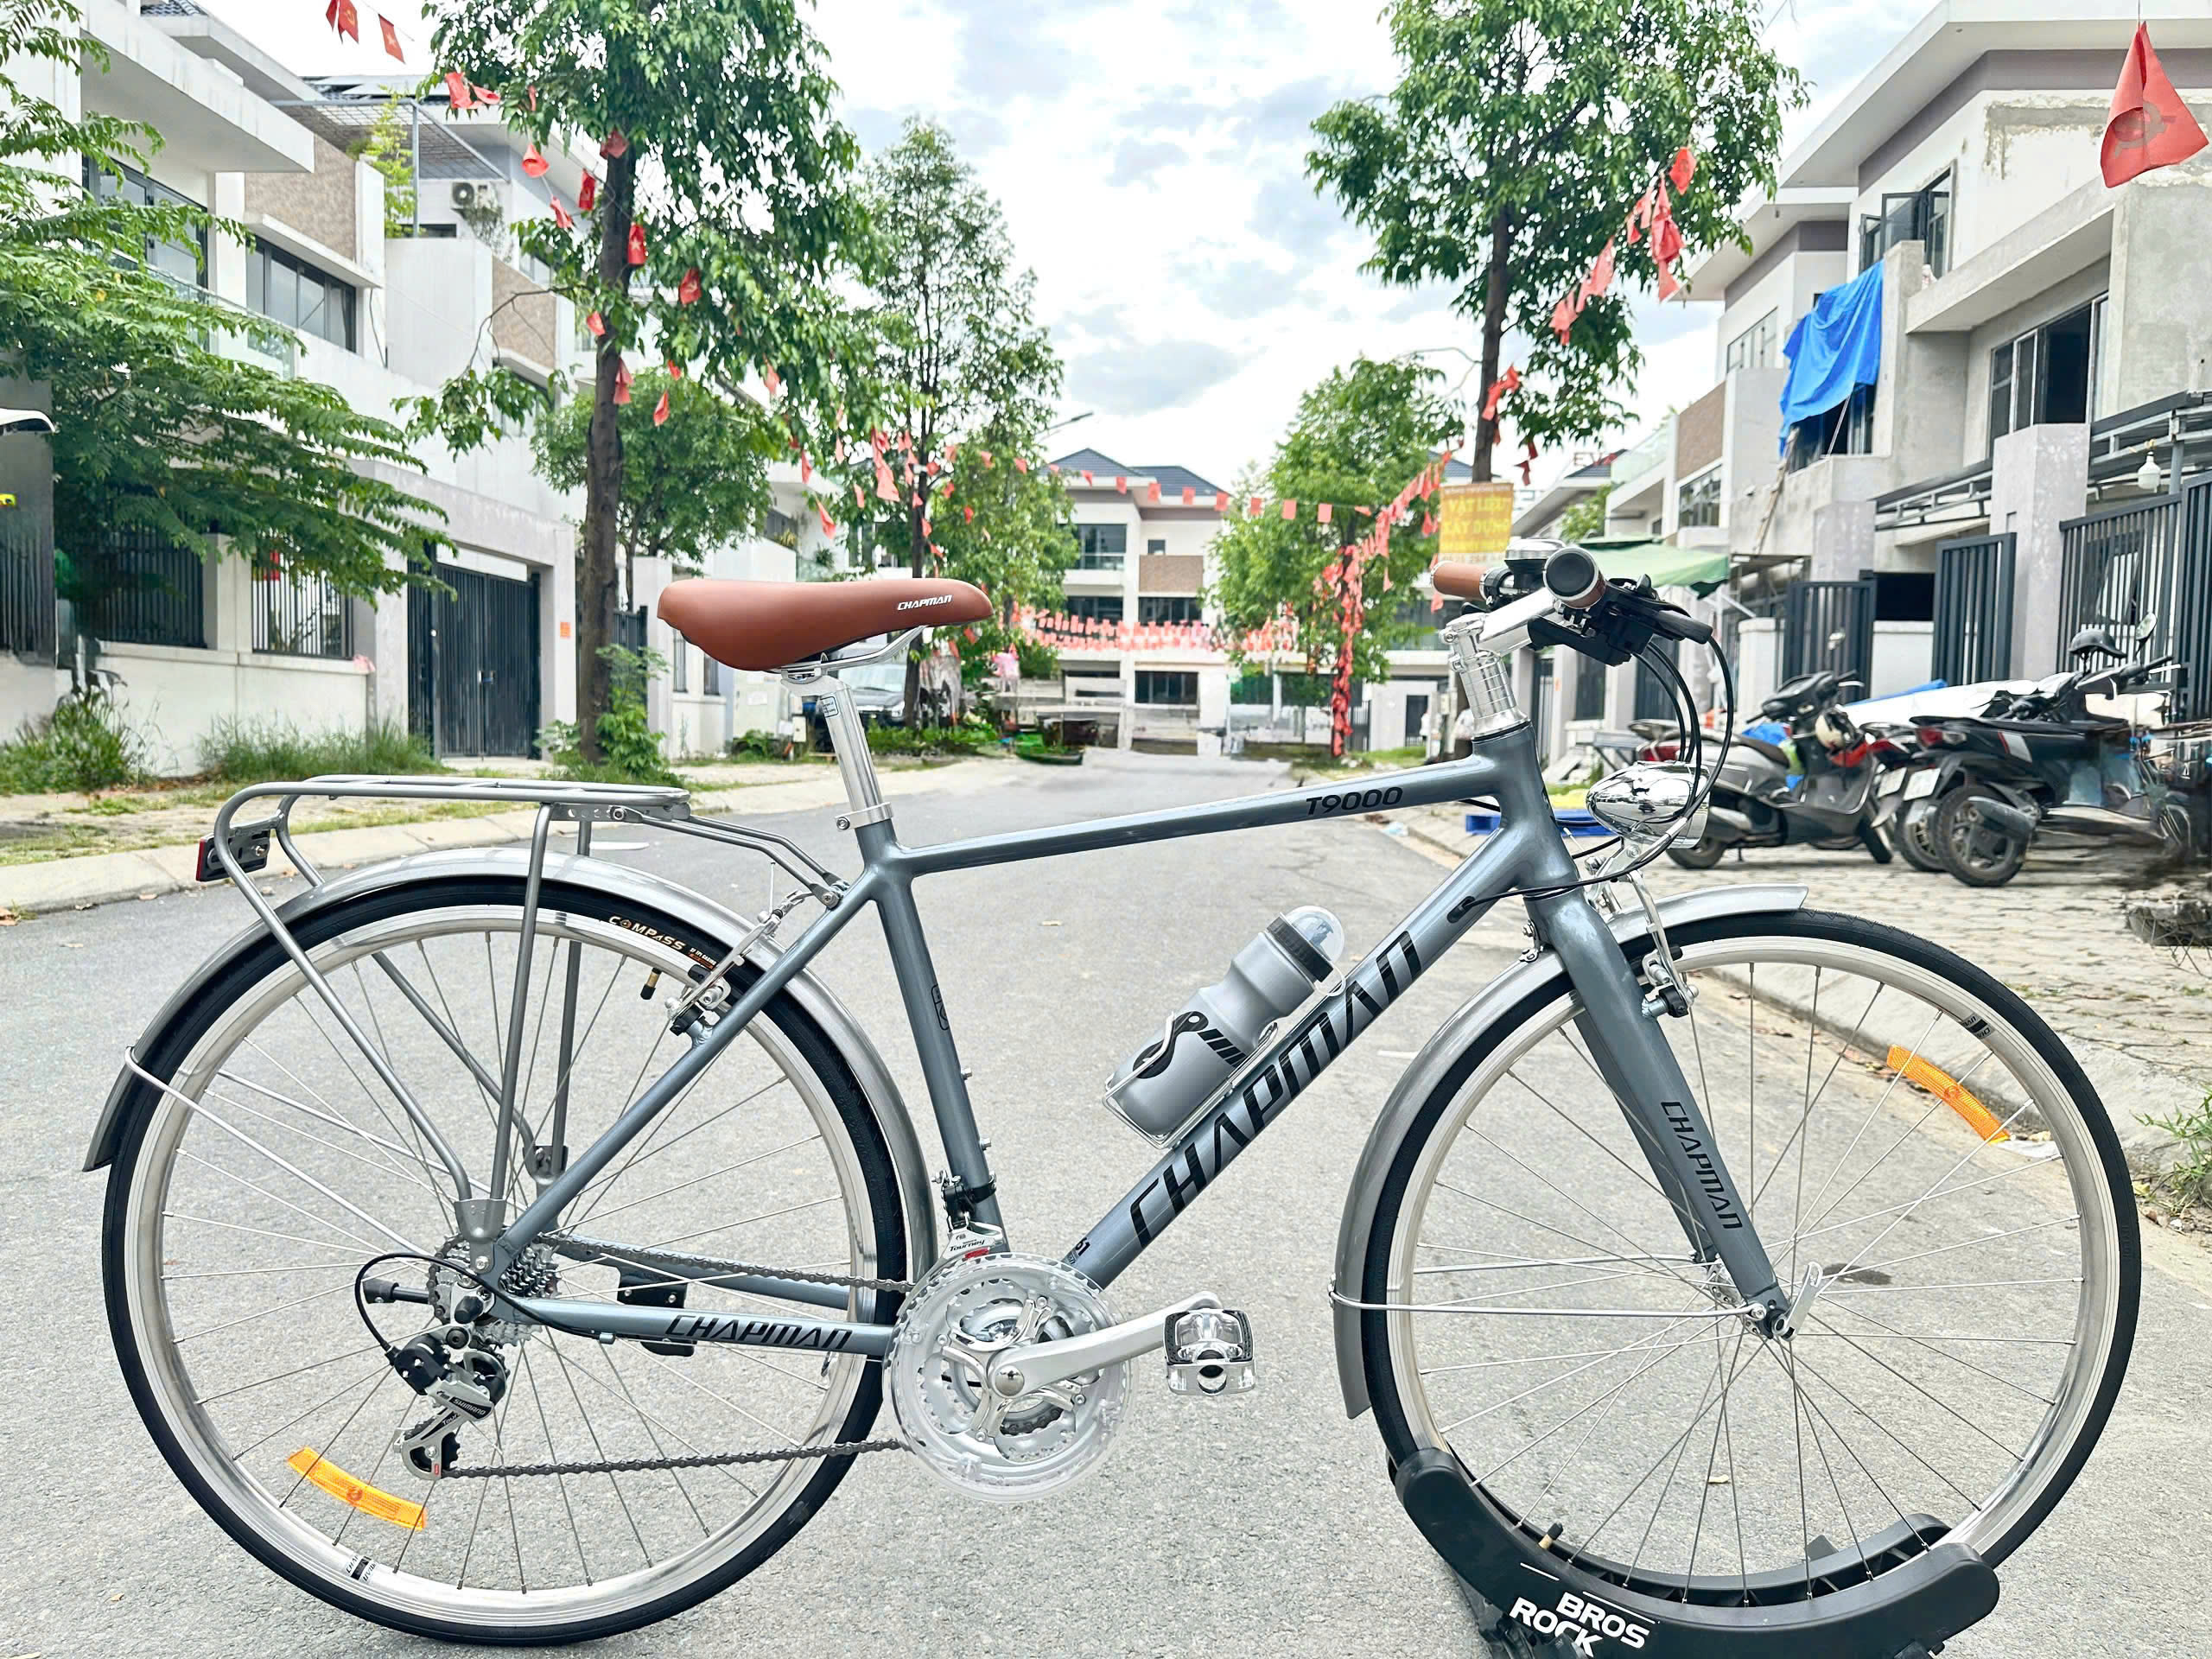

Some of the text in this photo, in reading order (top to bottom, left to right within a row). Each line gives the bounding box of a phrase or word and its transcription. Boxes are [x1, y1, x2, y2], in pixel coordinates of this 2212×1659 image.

[897, 594, 953, 611] CHAPMAN
[1306, 786, 1403, 816] T9000
[608, 915, 686, 950] COMPASS
[1130, 931, 1422, 1249] CHAPMAN
[1661, 1102, 1743, 1229] CHAPMAN
[950, 1240, 985, 1251] Tourney
[664, 1314, 853, 1350] CHAPMAN
[453, 1399, 486, 1415] SHIMANO
[1555, 1592, 1649, 1649] BROS
